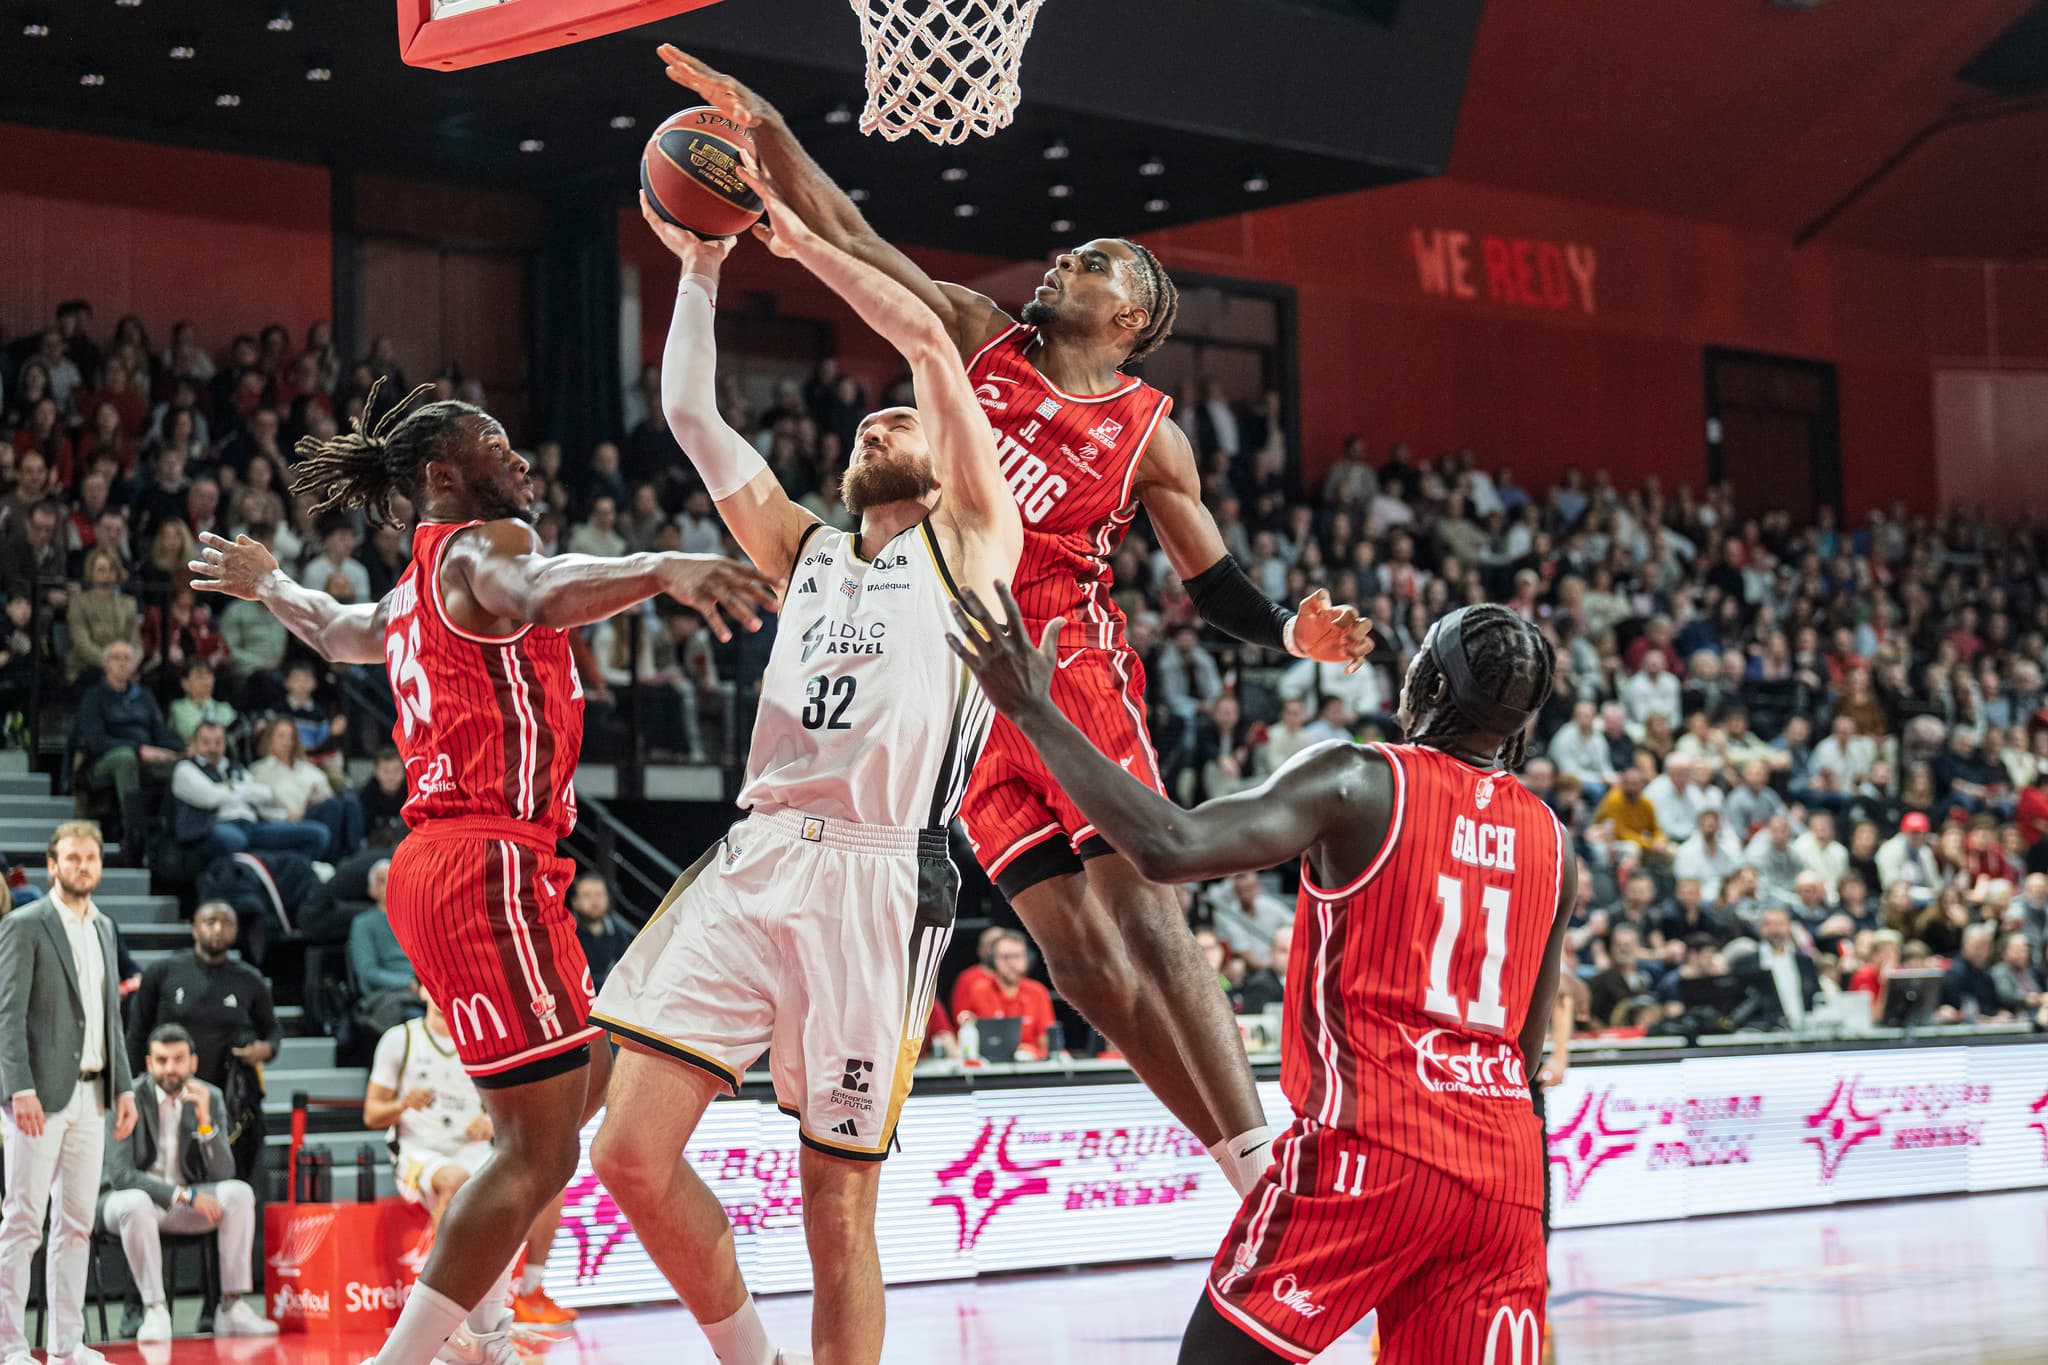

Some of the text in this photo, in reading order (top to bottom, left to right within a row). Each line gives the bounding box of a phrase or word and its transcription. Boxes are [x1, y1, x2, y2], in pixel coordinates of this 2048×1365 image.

[1408, 227, 1597, 315] WE REDY
[826, 642, 884, 654] ASVEL
[829, 620, 886, 641] LDLC
[801, 674, 857, 730] 32
[1451, 814, 1516, 871] GACH
[1424, 874, 1510, 1028] 11
[830, 1096, 872, 1111] DU FUTUR
[832, 1089, 873, 1104] Entreprise
[1333, 1150, 1367, 1196] 11
